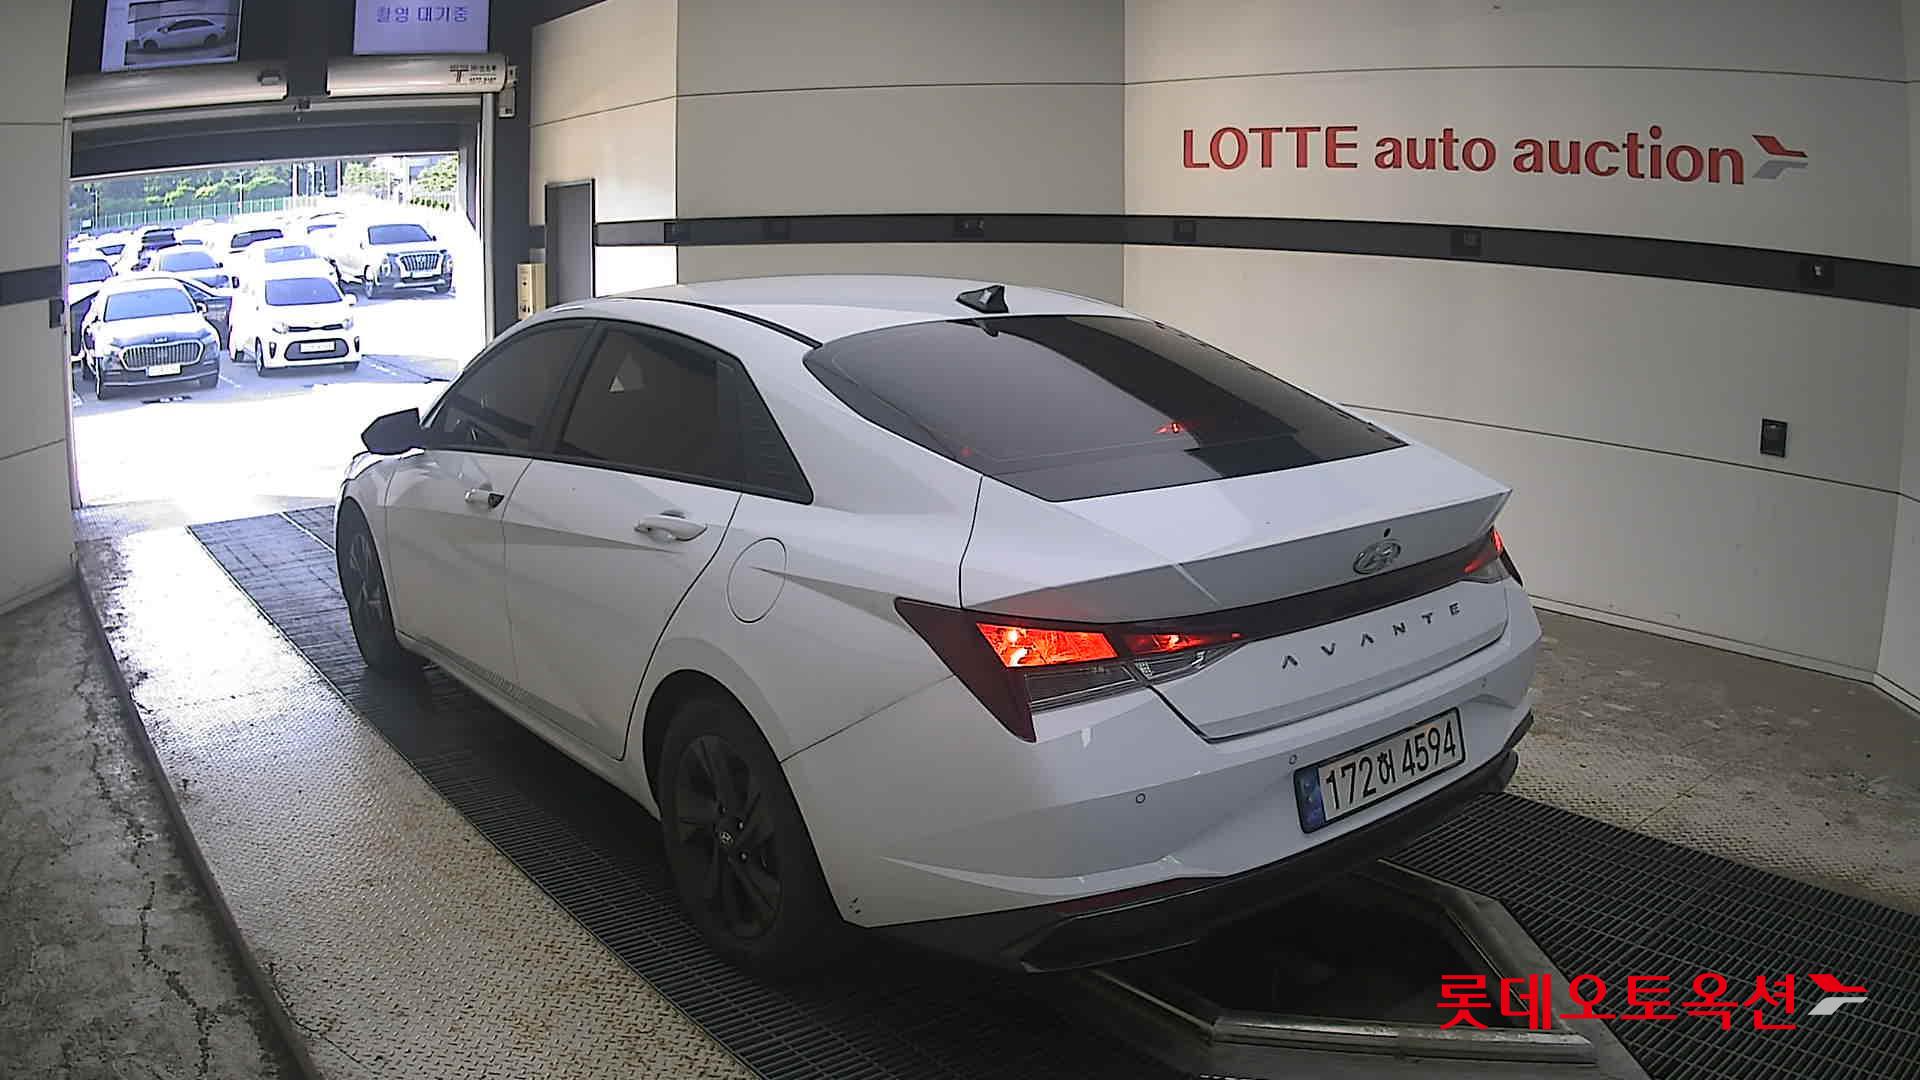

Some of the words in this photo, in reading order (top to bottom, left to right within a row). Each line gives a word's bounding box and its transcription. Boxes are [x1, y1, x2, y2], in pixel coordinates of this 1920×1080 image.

[1183, 126, 1358, 170] LOTTE
[1374, 128, 1496, 171] auto
[1513, 125, 1744, 185] auction
[1282, 602, 1461, 669] AVANTE
[1402, 720, 1456, 776] 4594
